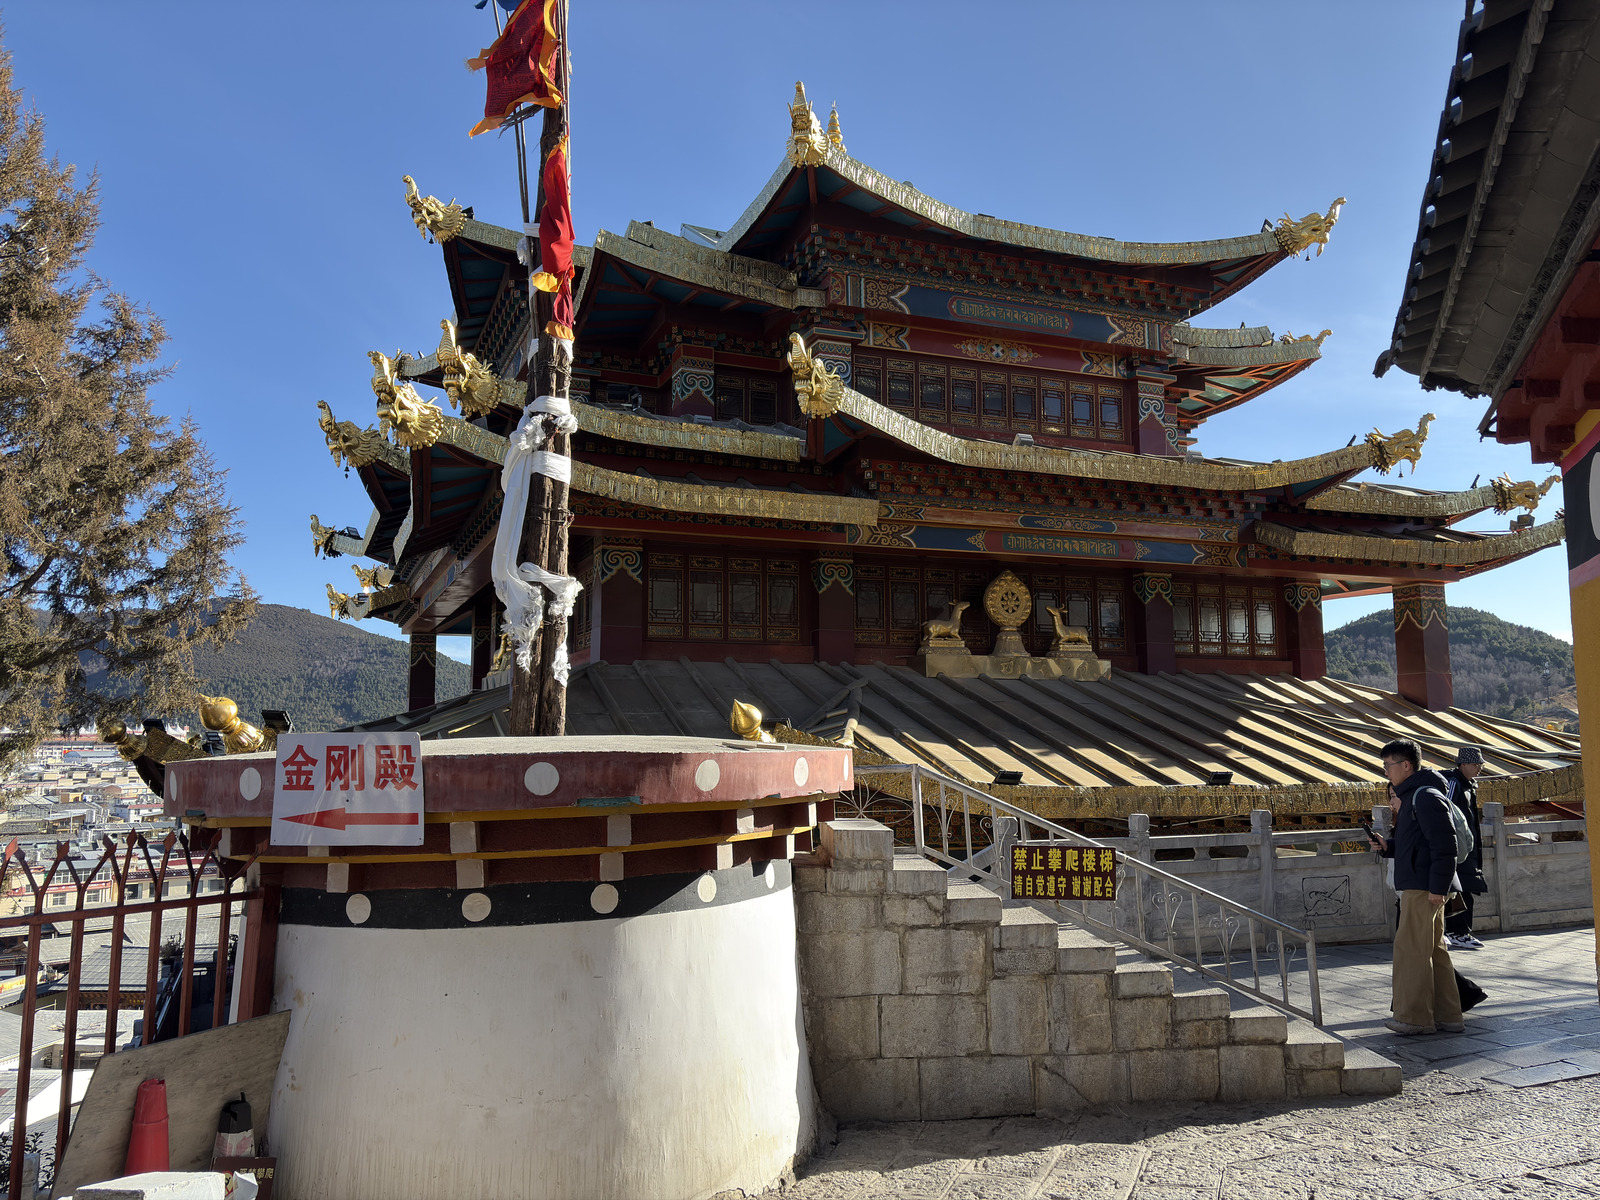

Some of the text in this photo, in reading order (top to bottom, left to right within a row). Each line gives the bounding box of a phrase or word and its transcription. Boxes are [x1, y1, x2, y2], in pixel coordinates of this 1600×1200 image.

[281, 744, 419, 792] 金刚殿
[1013, 847, 1114, 873] 禁止攀爬楼梯
[1013, 874, 1114, 898] 请自觉遵守 谢谢配合
